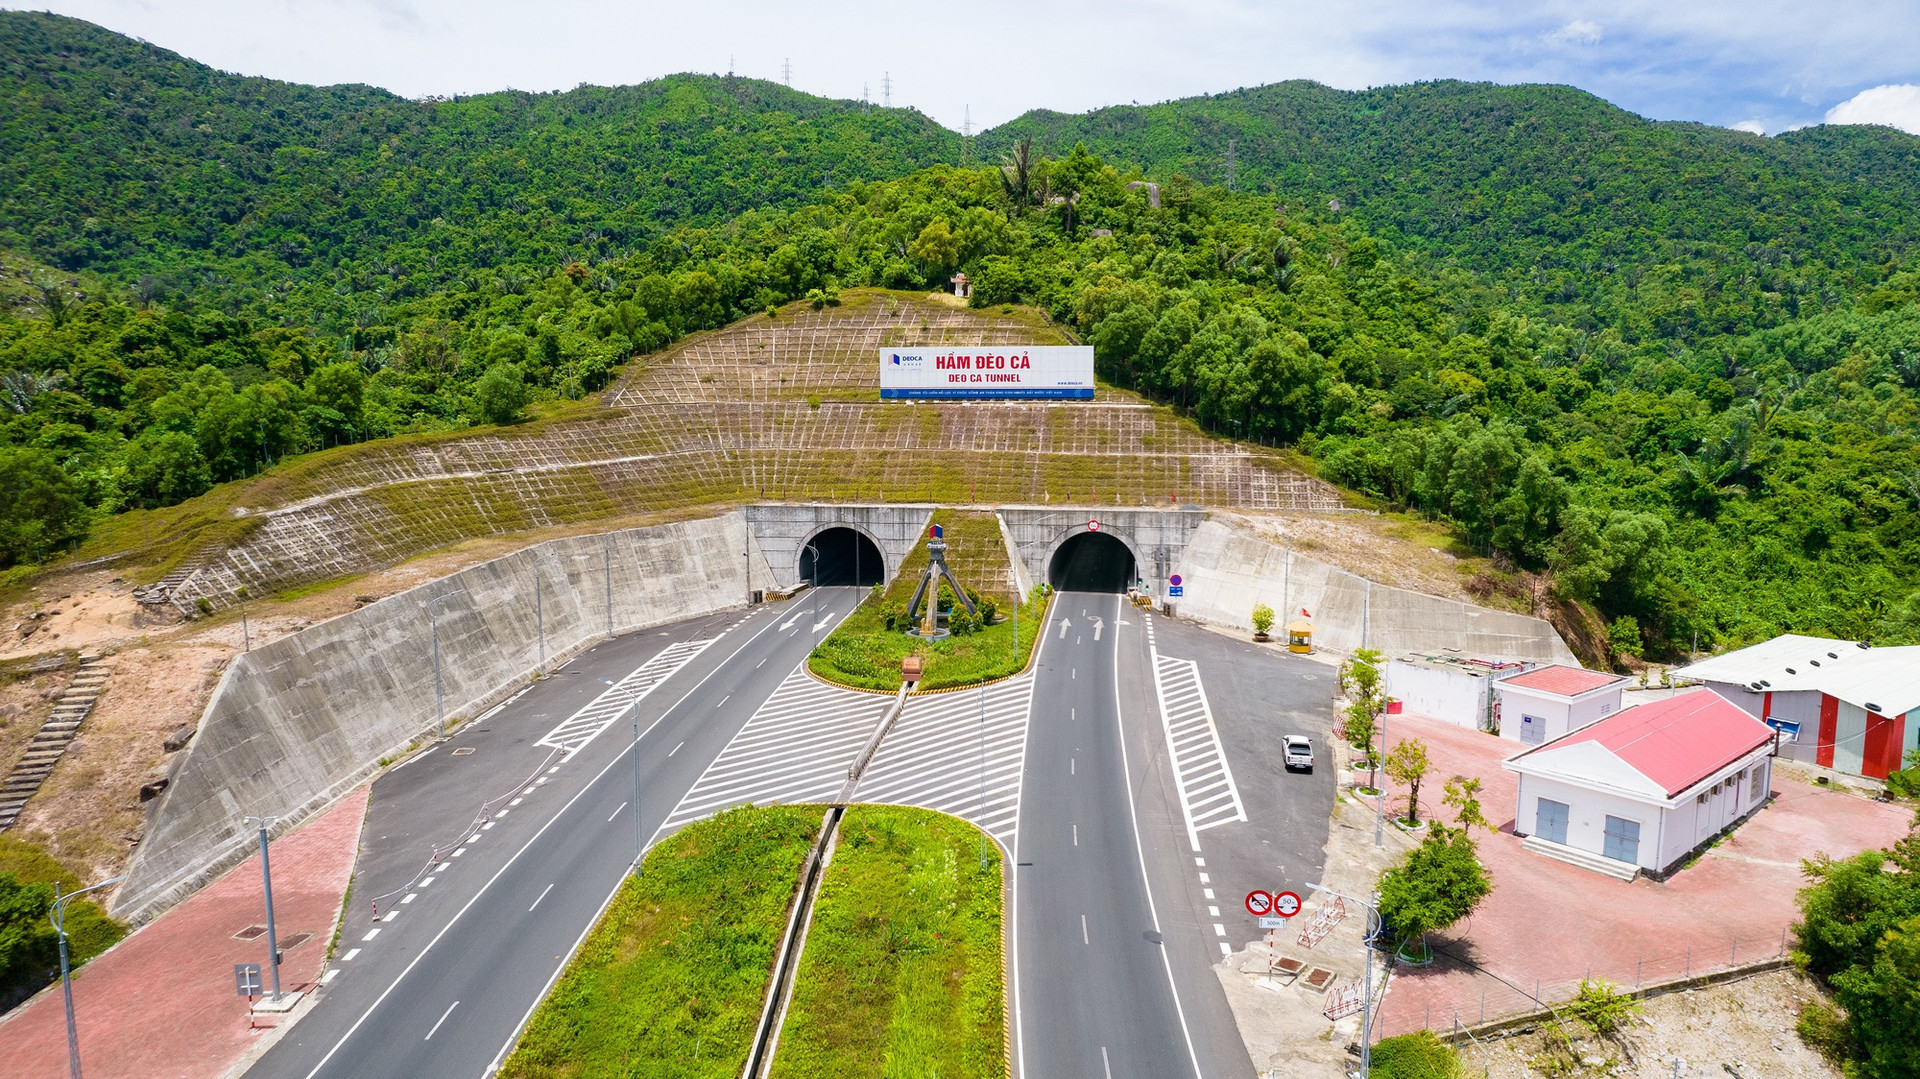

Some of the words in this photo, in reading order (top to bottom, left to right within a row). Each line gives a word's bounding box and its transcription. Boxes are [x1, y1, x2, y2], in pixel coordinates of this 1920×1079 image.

[936, 351, 970, 369] HẦM
[976, 352, 1005, 369] ĐÈO
[1010, 350, 1031, 369] CẢ
[949, 373, 967, 383] DEO
[970, 373, 982, 383] CA
[985, 373, 1021, 383] TUNNEL
